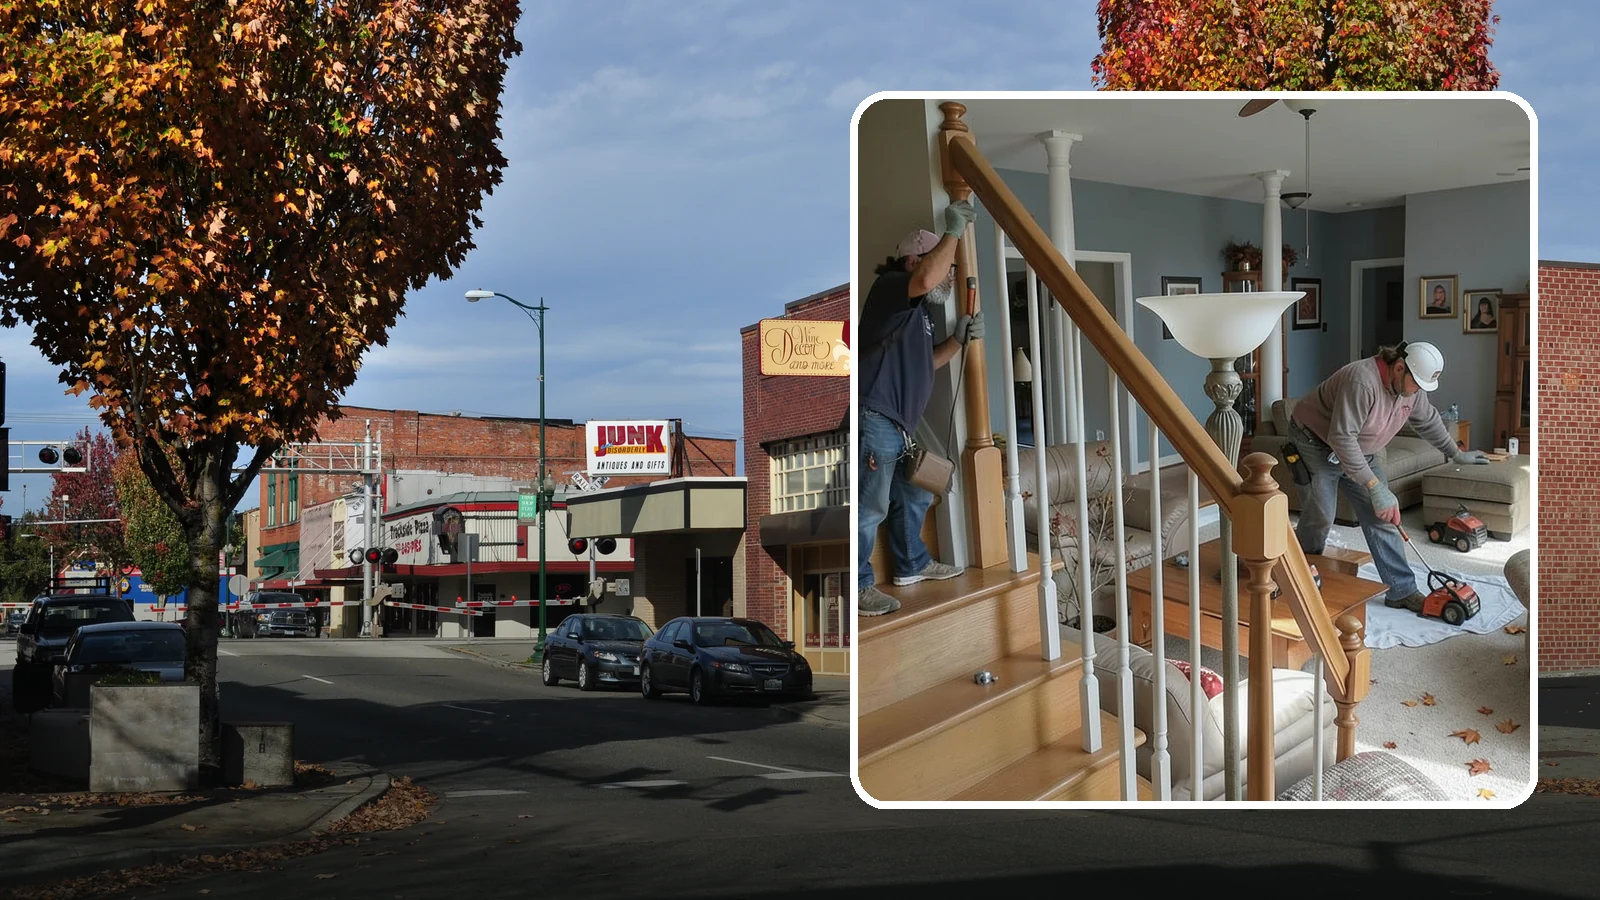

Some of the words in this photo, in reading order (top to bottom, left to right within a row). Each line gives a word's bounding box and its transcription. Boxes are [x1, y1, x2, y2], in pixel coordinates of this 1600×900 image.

[596, 425, 665, 457] JUNK
[607, 446, 646, 454] DISORDERLY
[597, 461, 628, 470] ANTIQUES
[631, 461, 644, 470] AND
[647, 460, 665, 470] GIFTS
[414, 519, 429, 535] Pizza
